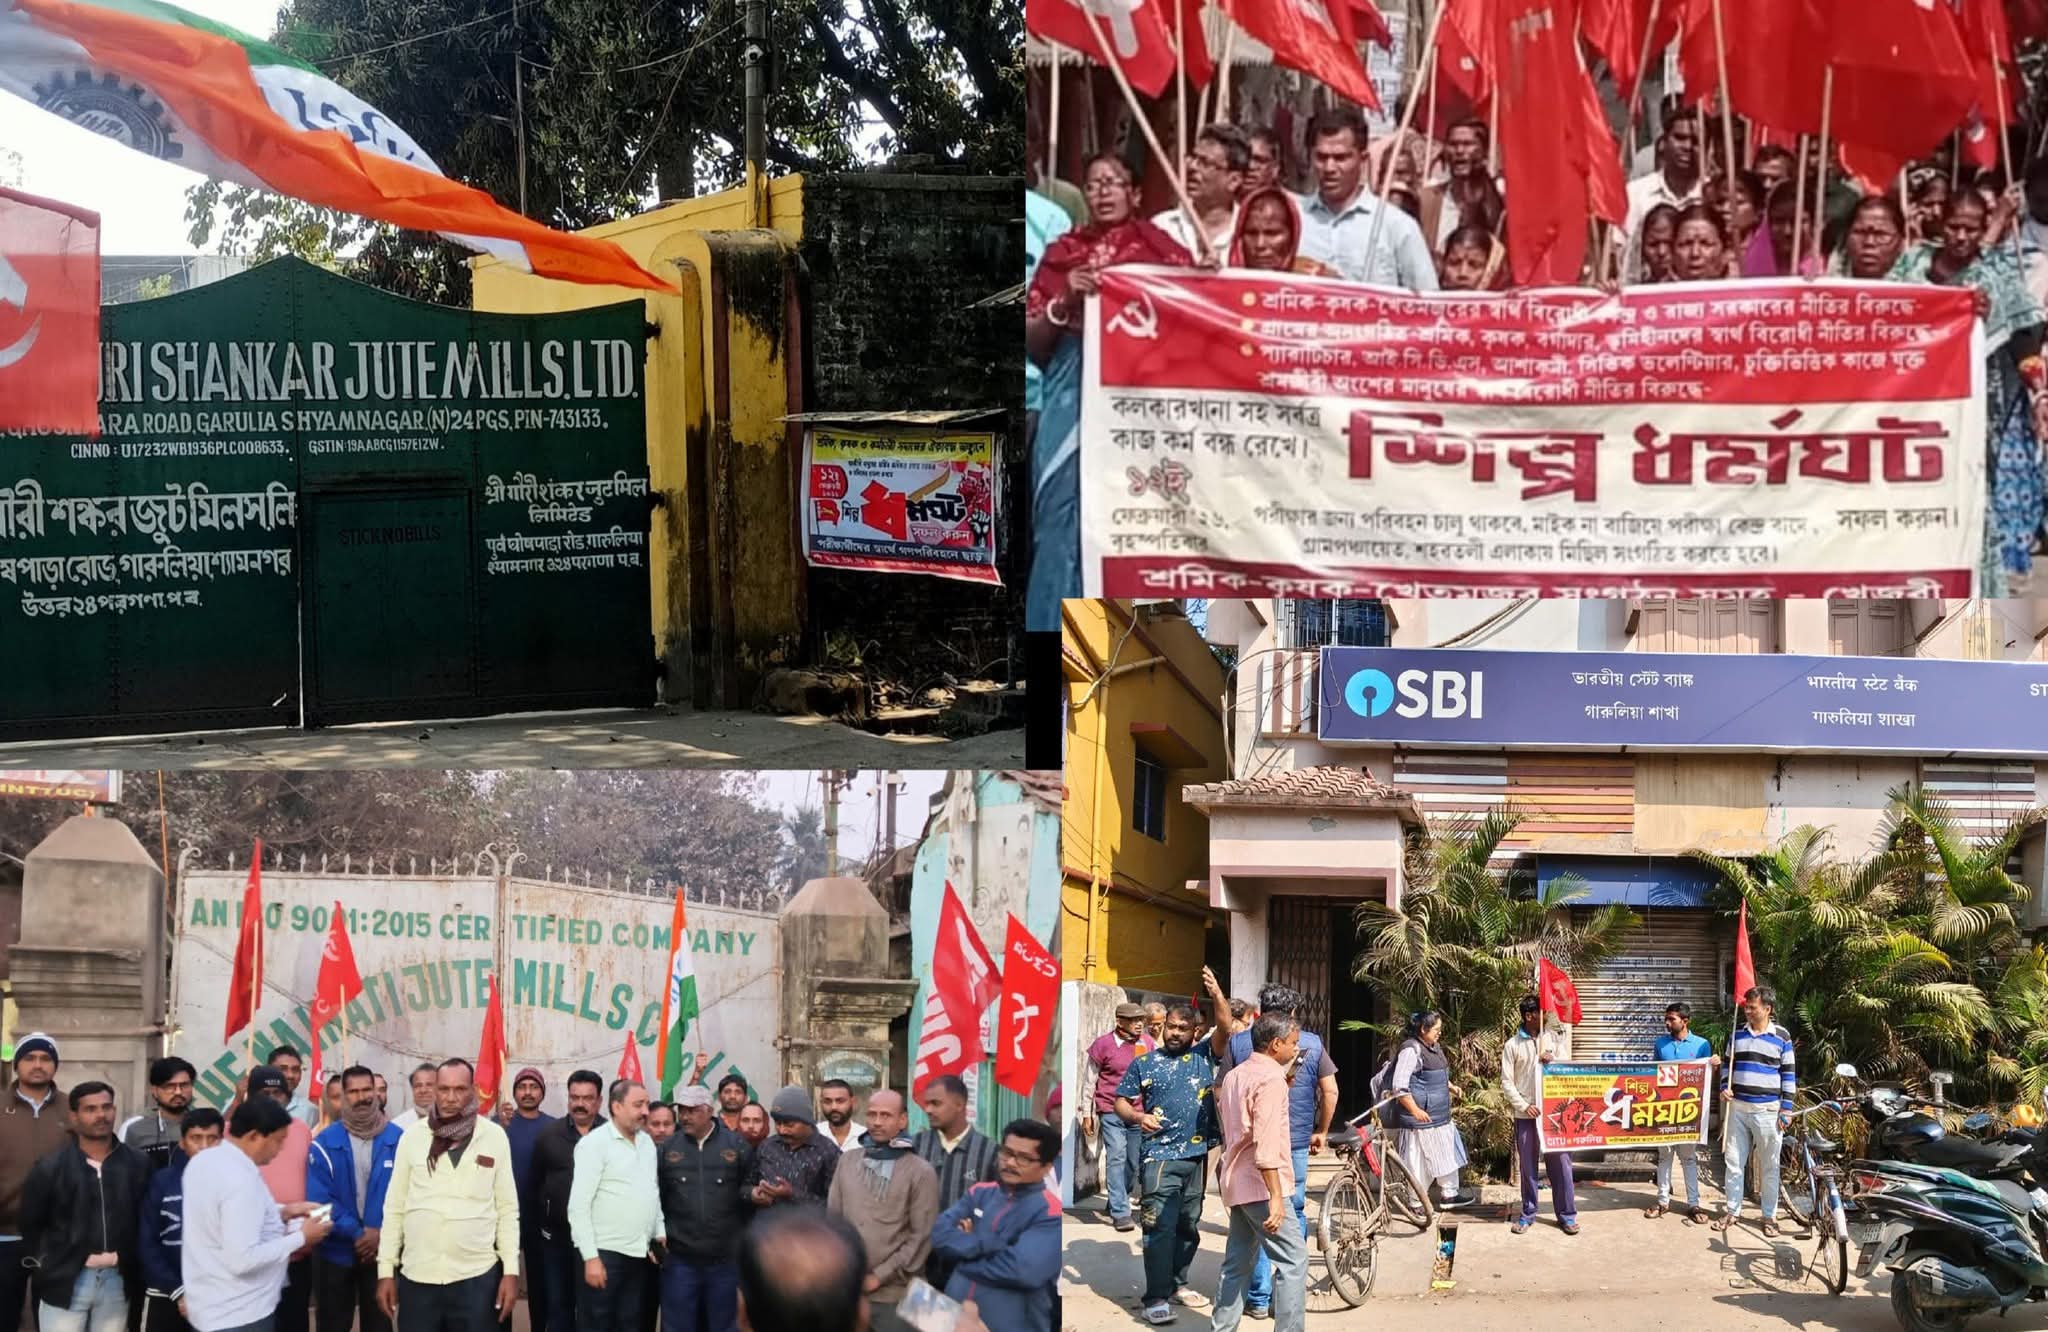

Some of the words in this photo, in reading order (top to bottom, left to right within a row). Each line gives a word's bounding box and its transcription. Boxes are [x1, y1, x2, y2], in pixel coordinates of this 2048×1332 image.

[150, 341, 339, 401] SHANKAR
[345, 341, 437, 400] JUTE
[1341, 410, 1605, 503] শিল্প
[1633, 408, 1950, 486] ধর্মঘট
[1395, 669, 1483, 719] SBI
[1571, 668, 1624, 688] ভারতীয়
[1807, 671, 1856, 691] भारतीय
[1863, 674, 1889, 692] स्टेट
[1649, 704, 1681, 721] শাখা
[1812, 707, 1872, 726] गारुलिया
[1878, 710, 1916, 728] शाखा
[191, 898, 228, 928] AN
[237, 899, 282, 930] IO
[612, 922, 756, 956] COMANY
[513, 957, 634, 1031] MILLS
